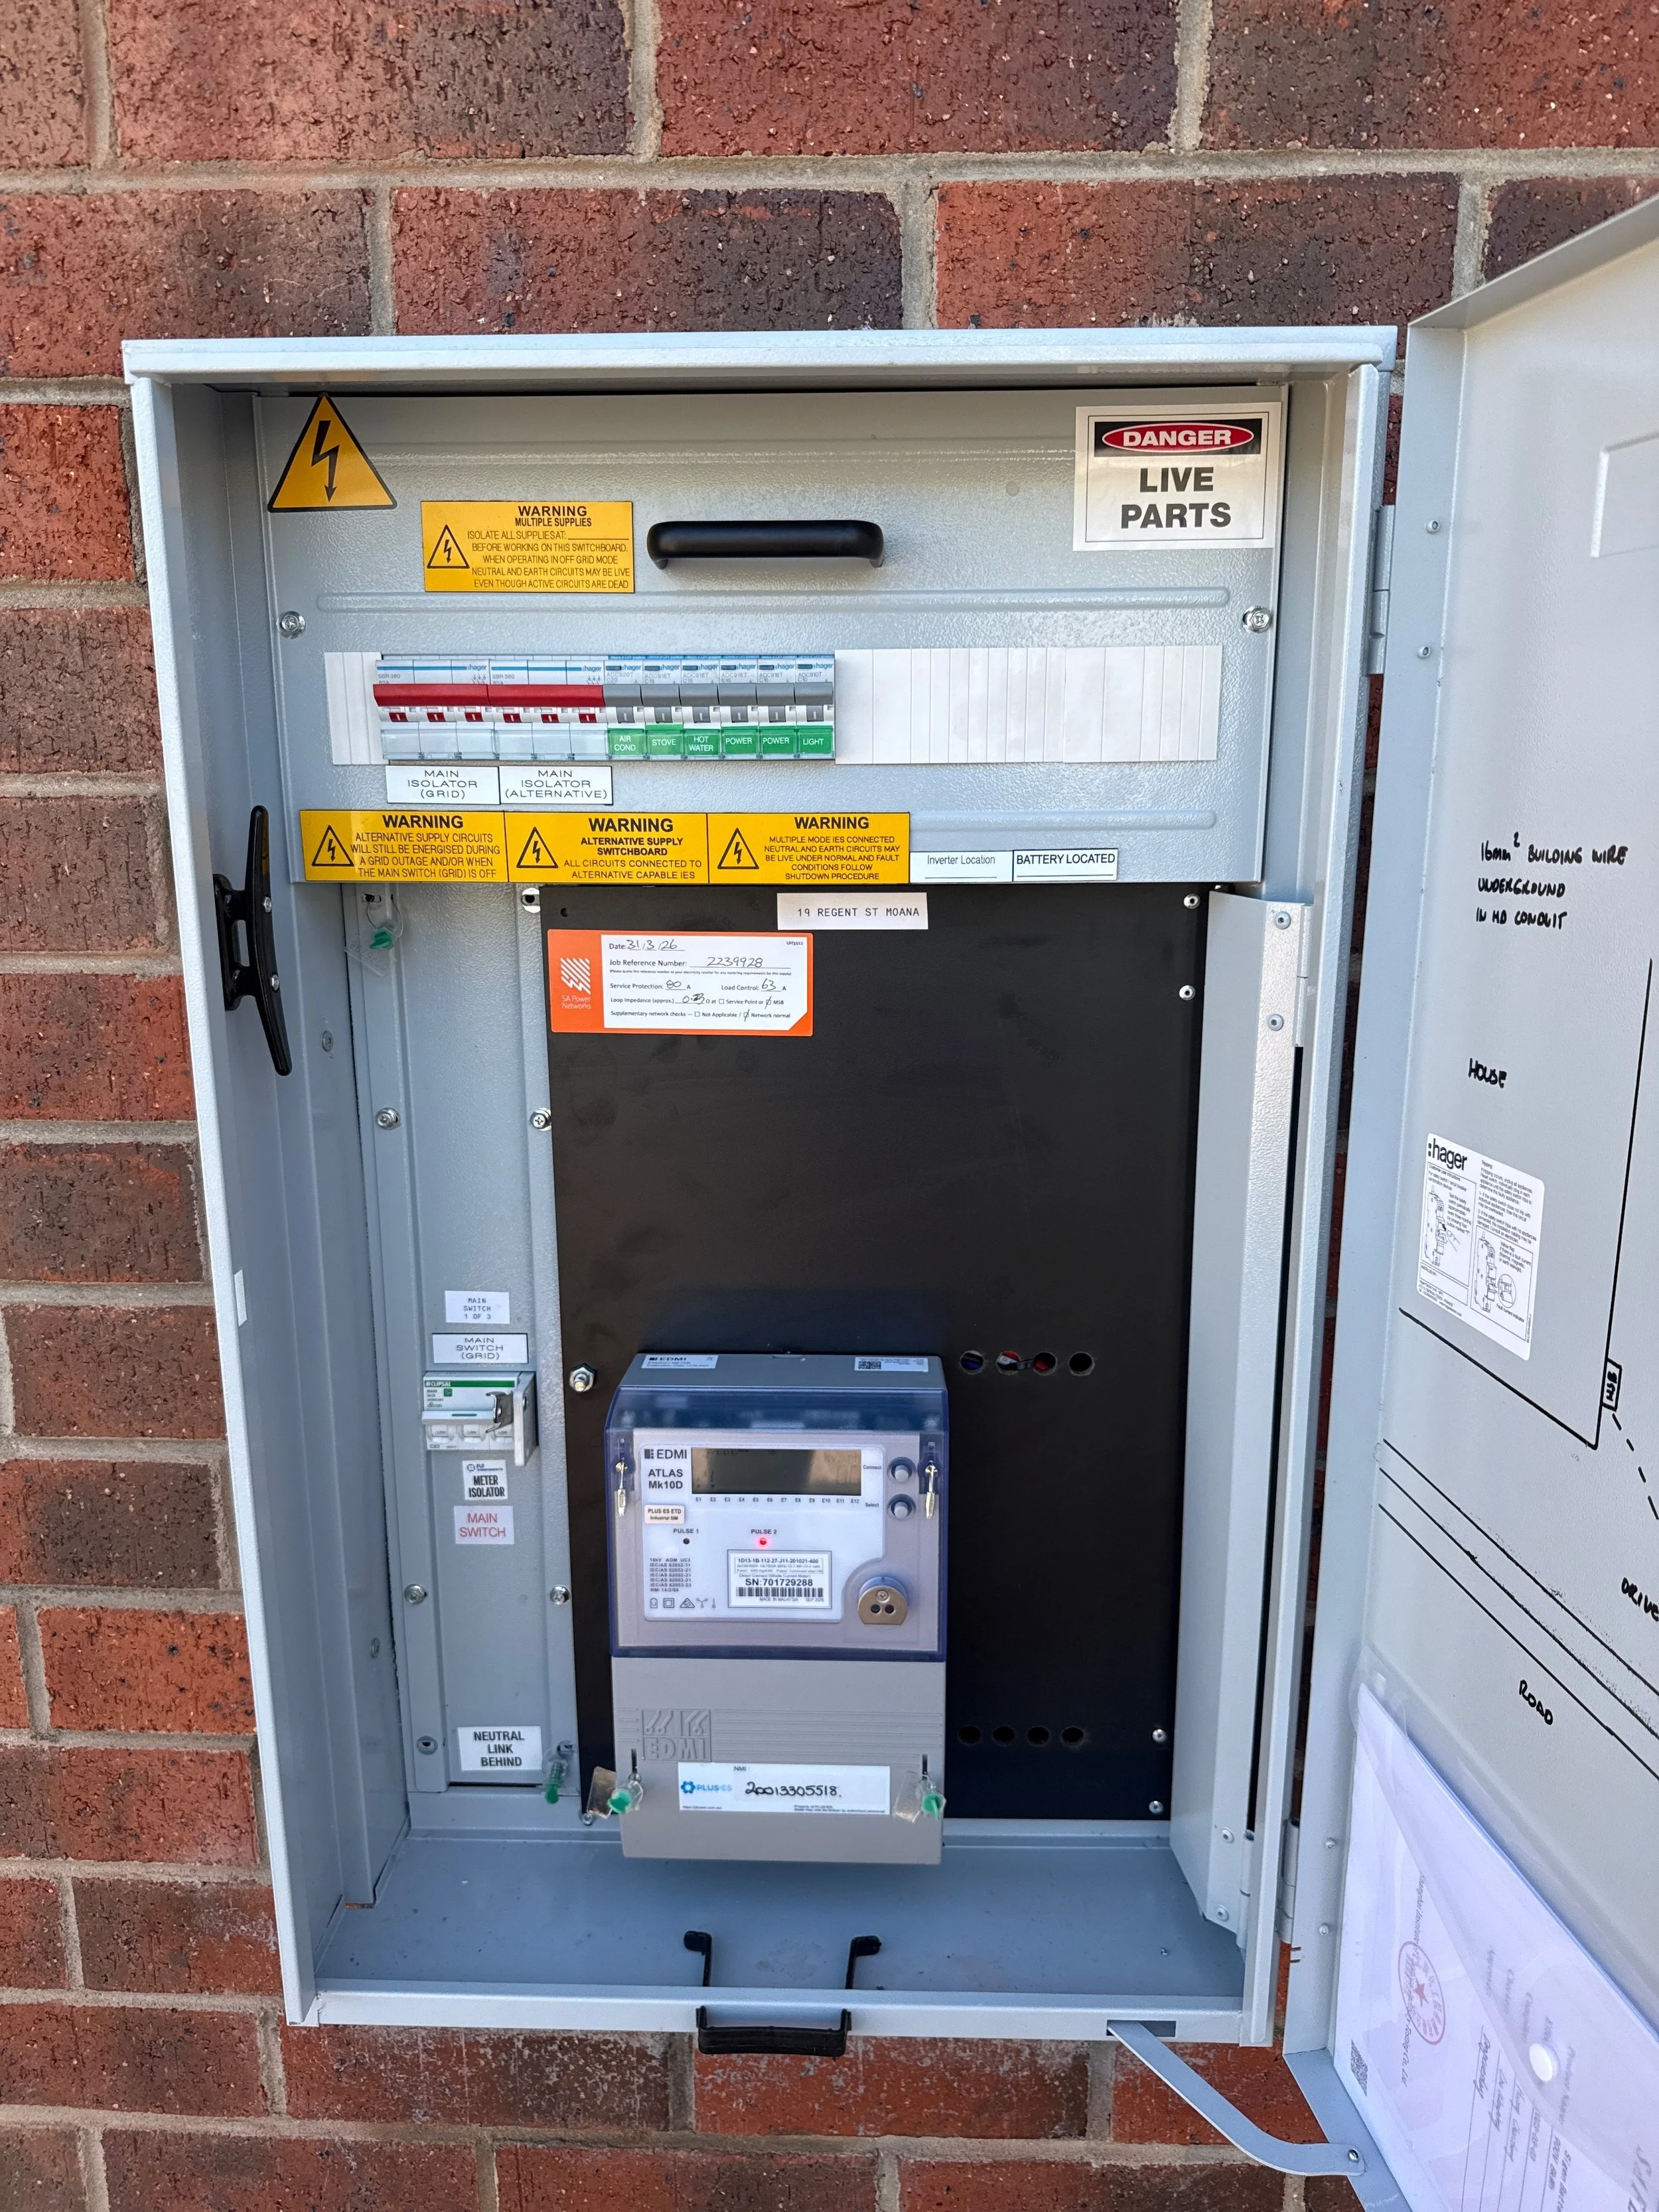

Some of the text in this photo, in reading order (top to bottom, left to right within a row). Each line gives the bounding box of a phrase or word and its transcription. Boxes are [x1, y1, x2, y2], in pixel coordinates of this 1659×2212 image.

[1123, 430, 1232, 446] DANGER
[1140, 467, 1214, 492] LIVE
[518, 506, 587, 516] WARNING
[1121, 502, 1231, 528] PARTS
[515, 518, 592, 527] MULTIPLE SUPPLIES
[572, 544, 628, 552] SWITCHBOARD.
[421, 790, 465, 799] (GRID)
[505, 789, 607, 799] (ALTERNATIVE)
[382, 815, 464, 828] WARNING
[589, 818, 674, 832] WARNING
[794, 816, 869, 829] WARNING
[356, 833, 493, 842] ALTERNATIVE SUPPLY CIRCUITS
[1017, 853, 1115, 864] BATTERY LOCATED
[1528, 844, 1582, 865] BUILDING
[1592, 844, 1628, 865] WIRE
[360, 856, 493, 866] A GRID OUTAGE AND/OR WHEN
[927, 855, 995, 865] Inverter Location
[358, 868, 497, 878] THE MAIN SWITCH (GRID) IS OFF
[1477, 877, 1566, 897] UNDERGROUND
[798, 908, 919, 917] 19 REGENT ST MOANA
[1476, 907, 1486, 922] IN
[1514, 911, 1567, 929] CONDUIT
[707, 957, 763, 968] 2239928
[762, 978, 776, 991] 63
[1468, 1058, 1506, 1088] HOUSE
[657, 1449, 687, 1459] EDMI
[473, 1475, 498, 1485] METER
[469, 1487, 505, 1497] ISOLATOR
[467, 1513, 498, 1523] MAIN
[459, 1527, 506, 1537] SWITCH
[1519, 1679, 1553, 1725] ROAD
[474, 1731, 525, 1740] NEUTRAL
[488, 1744, 513, 1753] LINK
[647, 1737, 706, 1759] EDMI
[481, 1757, 522, 1766] BEHIND
